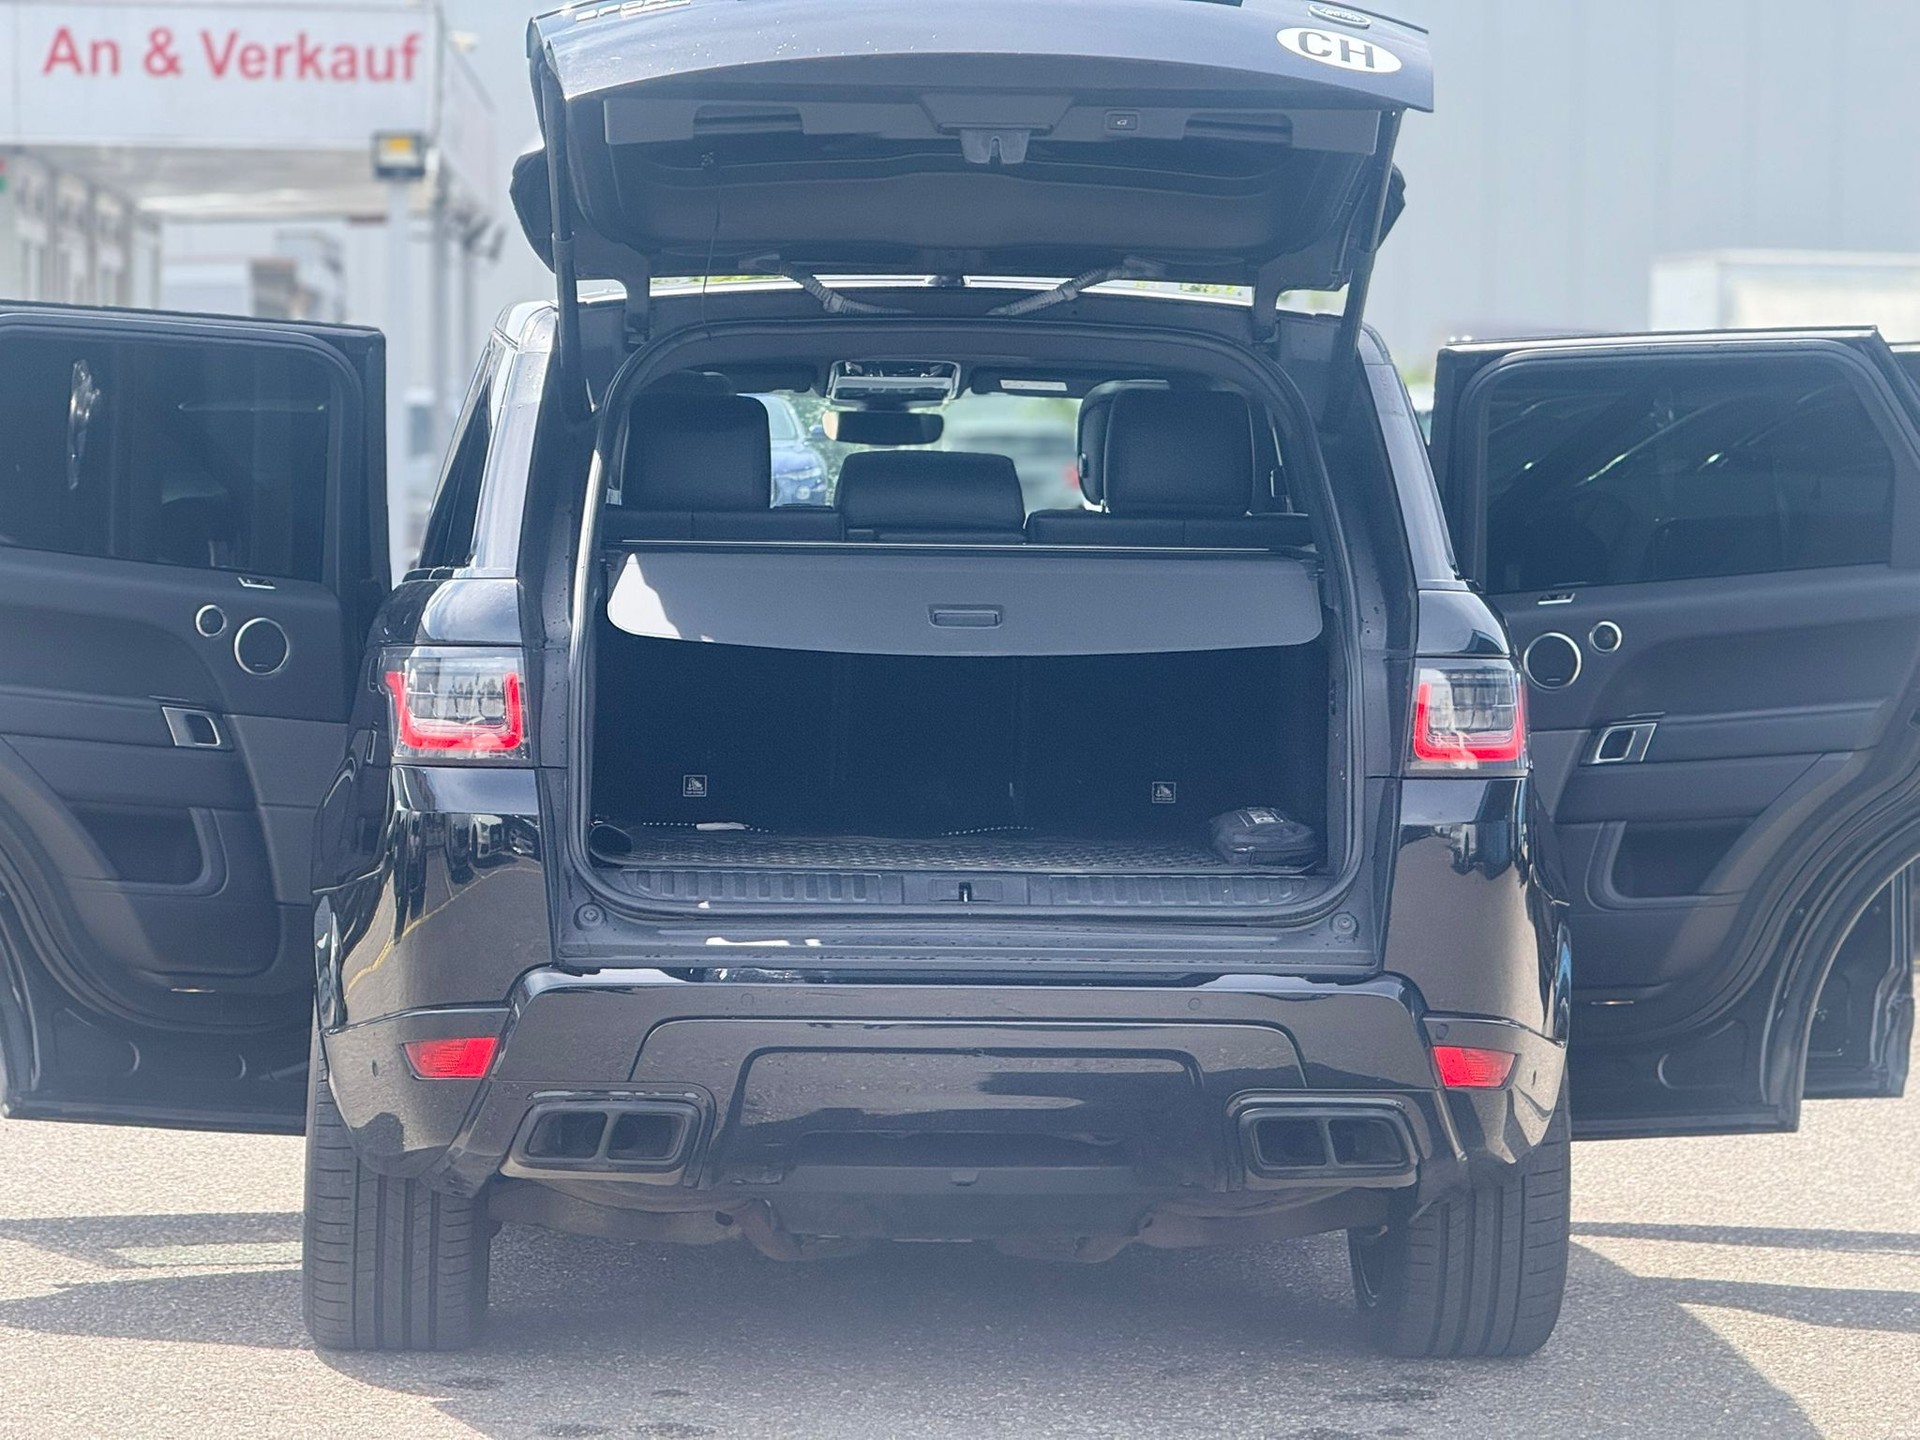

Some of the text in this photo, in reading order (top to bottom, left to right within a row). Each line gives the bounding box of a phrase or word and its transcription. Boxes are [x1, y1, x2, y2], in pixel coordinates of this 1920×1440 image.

[43, 25, 421, 82] An & Verkauf
[1298, 31, 1374, 68] CH
